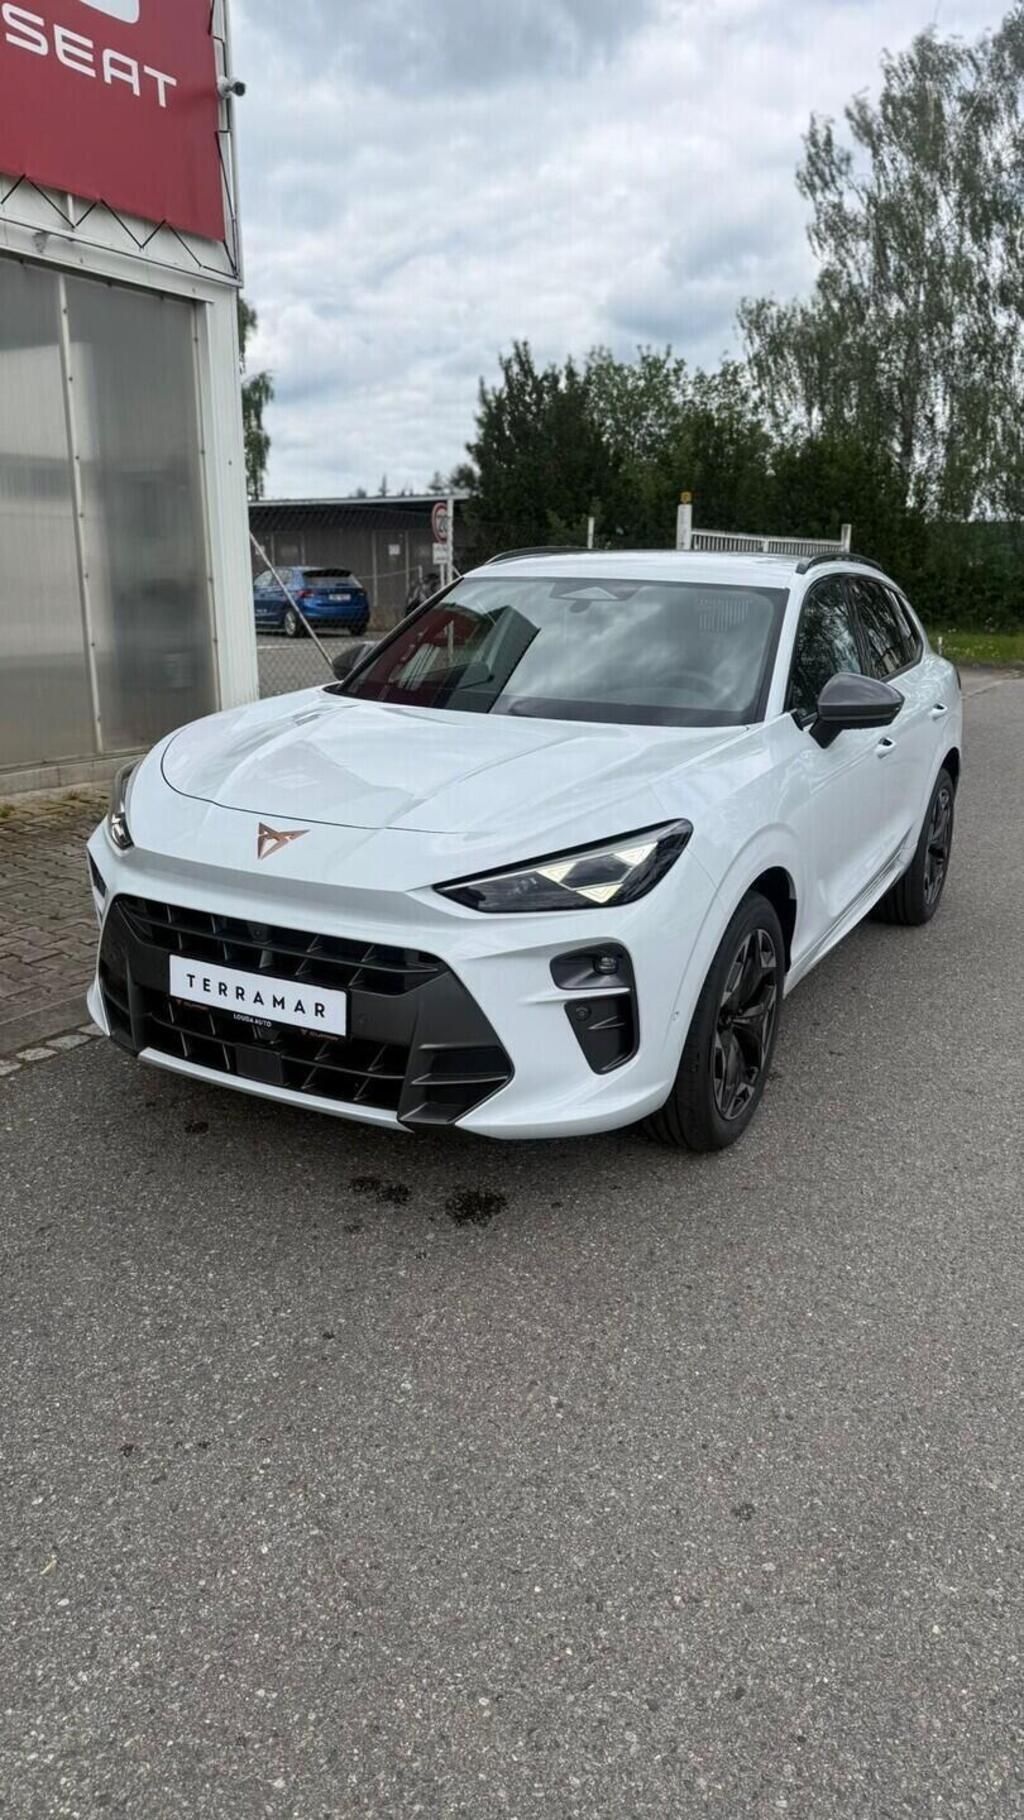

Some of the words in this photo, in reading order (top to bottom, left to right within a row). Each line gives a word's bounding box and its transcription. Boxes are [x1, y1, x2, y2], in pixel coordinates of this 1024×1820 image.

[2, 3, 177, 108] SEAT
[186, 973, 326, 1018] TERRAMAR
[254, 1018, 272, 1028] AUTO
